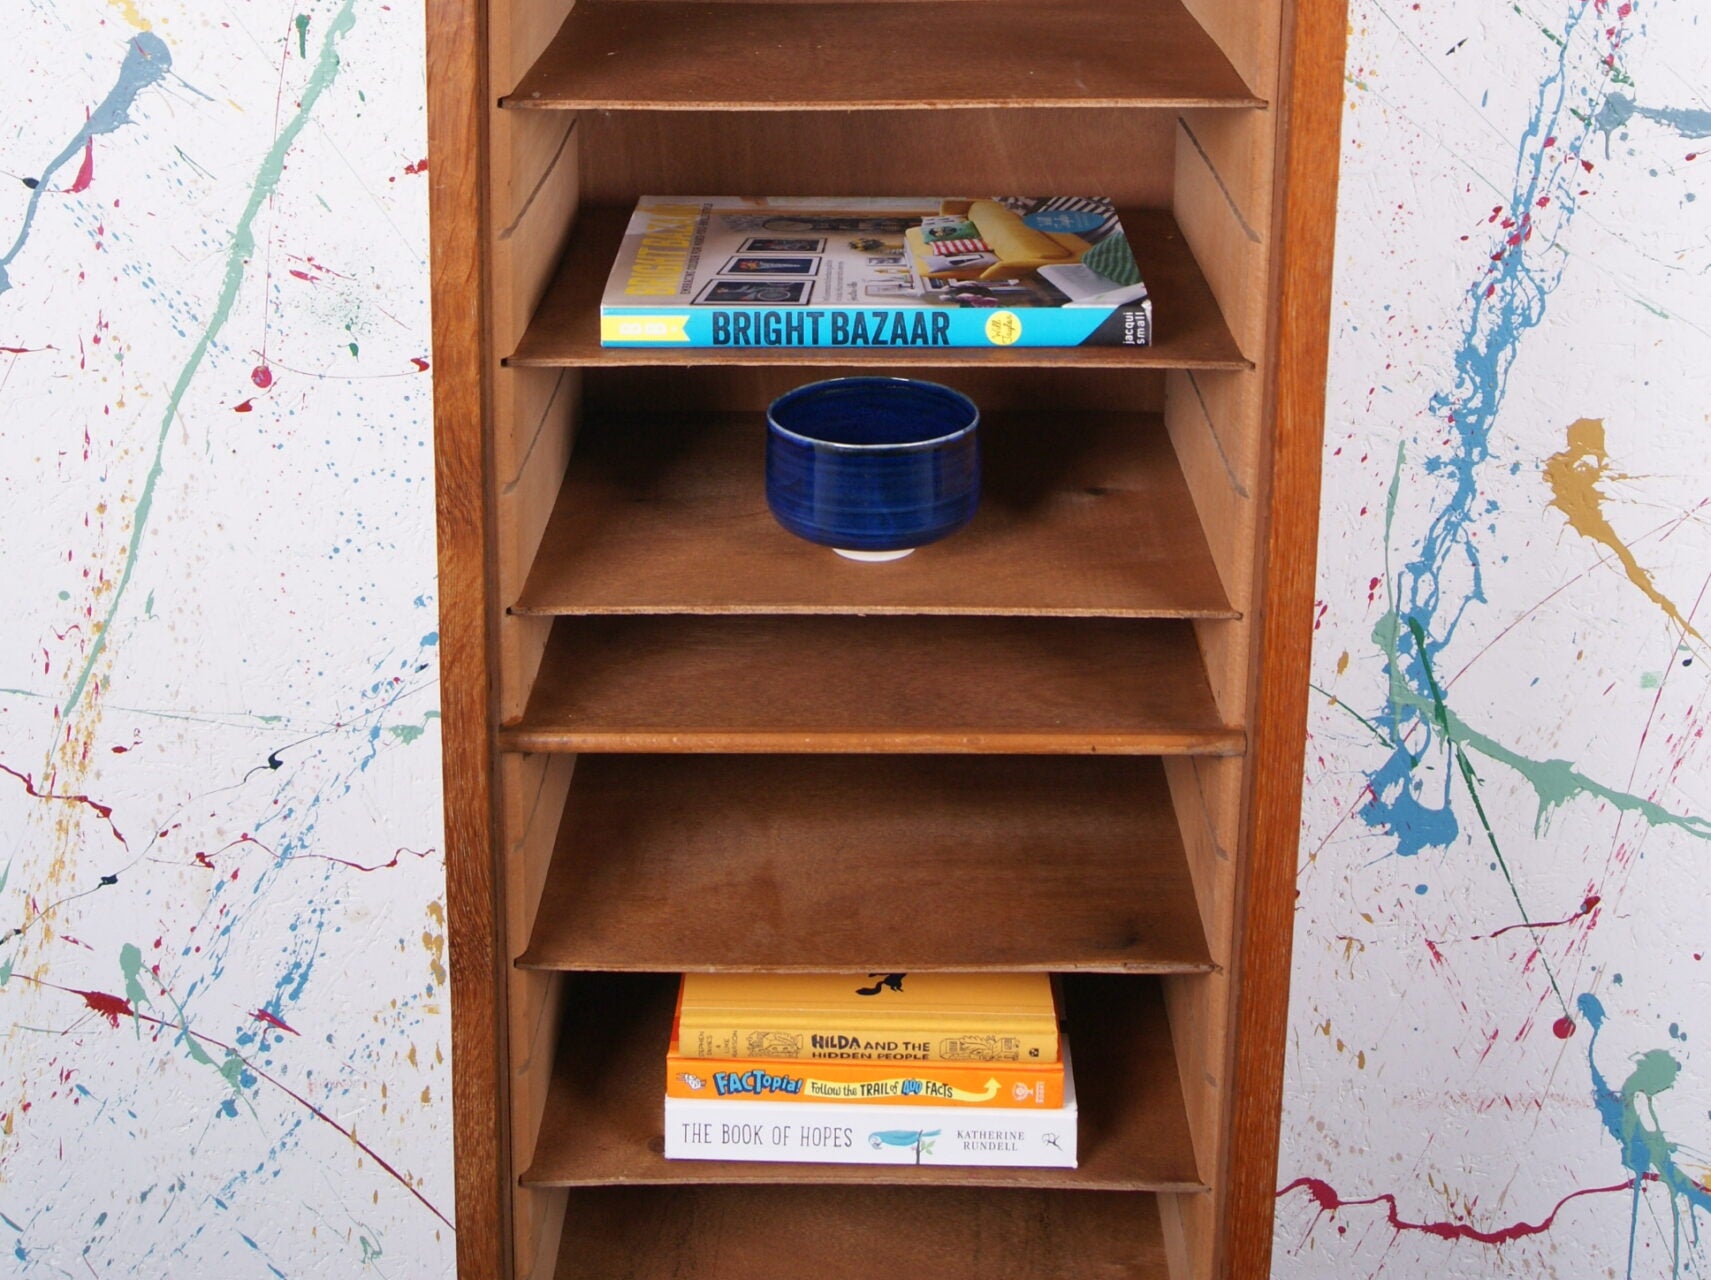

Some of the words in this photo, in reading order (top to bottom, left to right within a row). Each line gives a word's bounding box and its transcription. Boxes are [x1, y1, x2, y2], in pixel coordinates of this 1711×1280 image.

[712, 311, 824, 345] BRIGHT
[831, 311, 950, 345] BAZAAR
[1123, 312, 1134, 344] jacqui
[1135, 312, 1146, 344] small
[811, 1034, 861, 1050] HILDA
[864, 1041, 898, 1051] AND
[903, 1041, 930, 1052] THE
[877, 1052, 929, 1061] PEOPLE
[811, 1081, 841, 1096] Follow
[843, 1083, 857, 1096] the
[860, 1081, 890, 1096] TRAIL
[890, 1081, 899, 1096] of
[901, 1078, 923, 1096] 400
[682, 1123, 712, 1144] THE
[722, 1124, 763, 1145] BOOK
[772, 1125, 791, 1146] OF
[800, 1127, 853, 1148] HOPES
[957, 1130, 1025, 1141] KATHERINE
[963, 1141, 1018, 1151] RUNDELL
